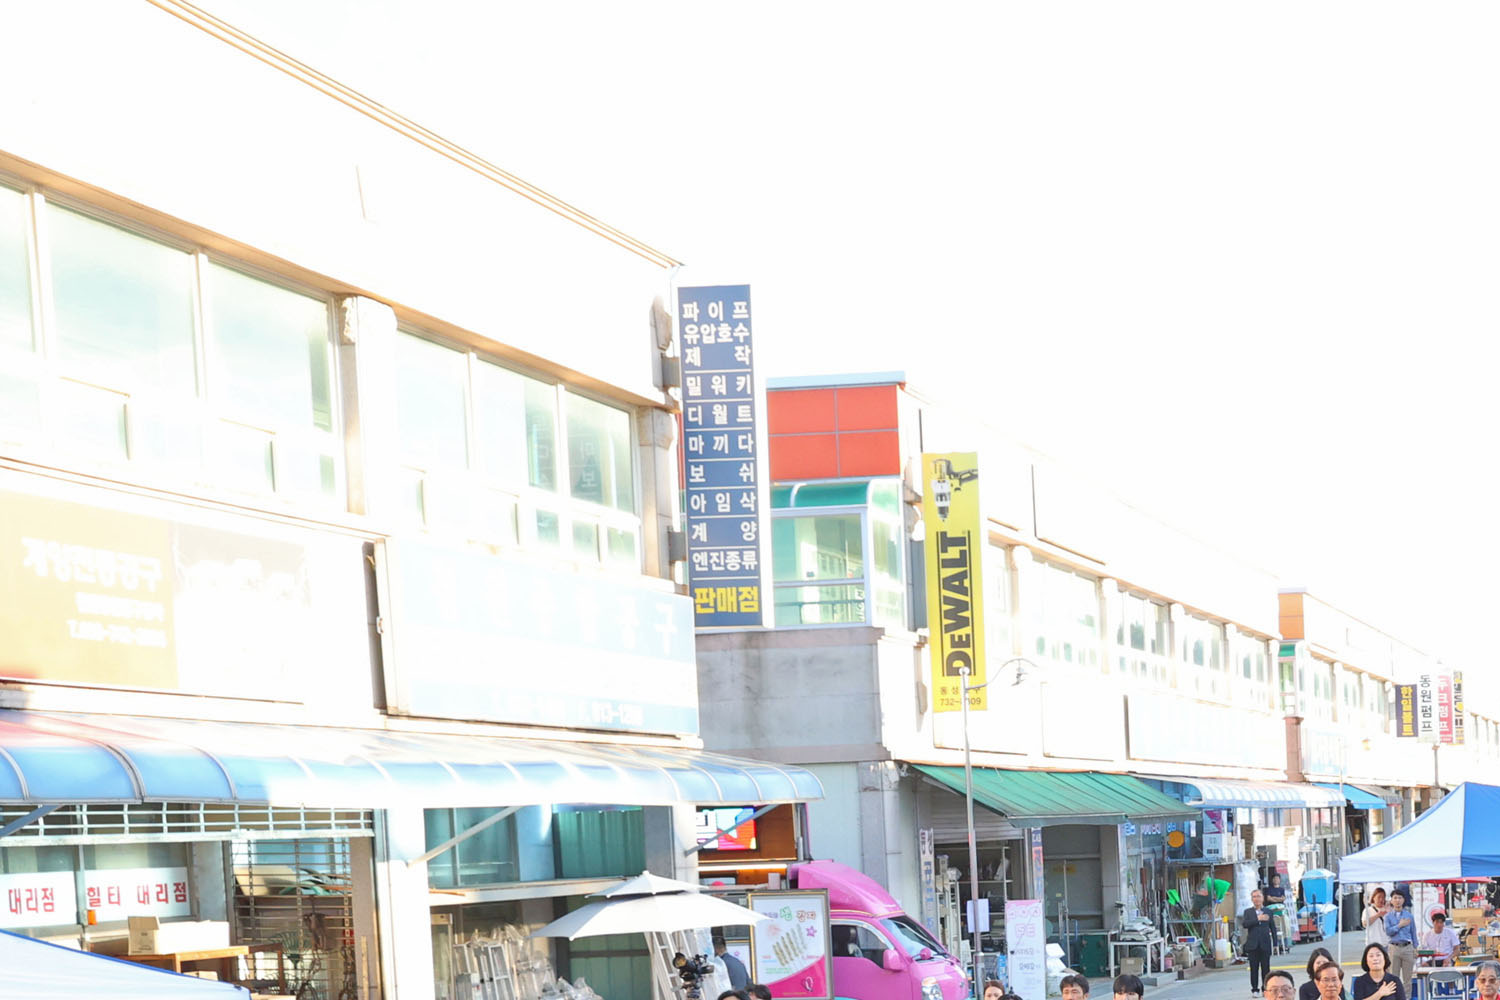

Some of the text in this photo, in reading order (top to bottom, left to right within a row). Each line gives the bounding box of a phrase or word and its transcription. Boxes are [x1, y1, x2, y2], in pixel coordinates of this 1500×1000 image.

[682, 301, 750, 320] 파이프
[683, 322, 750, 345] 유압호수
[685, 344, 752, 366] 제작
[686, 375, 752, 397] 밀워키
[687, 404, 753, 426] 디월트
[688, 432, 755, 455] 마끼다
[689, 460, 756, 483] 보쉬
[690, 490, 757, 513] 아임삭
[691, 519, 758, 543] 계양
[691, 550, 758, 573] 엔진종류
[694, 585, 760, 615] 판매점
[939, 530, 973, 677] DEWALT
[8, 886, 55, 915] 대리점
[86, 881, 187, 909] 힐티 대리점
